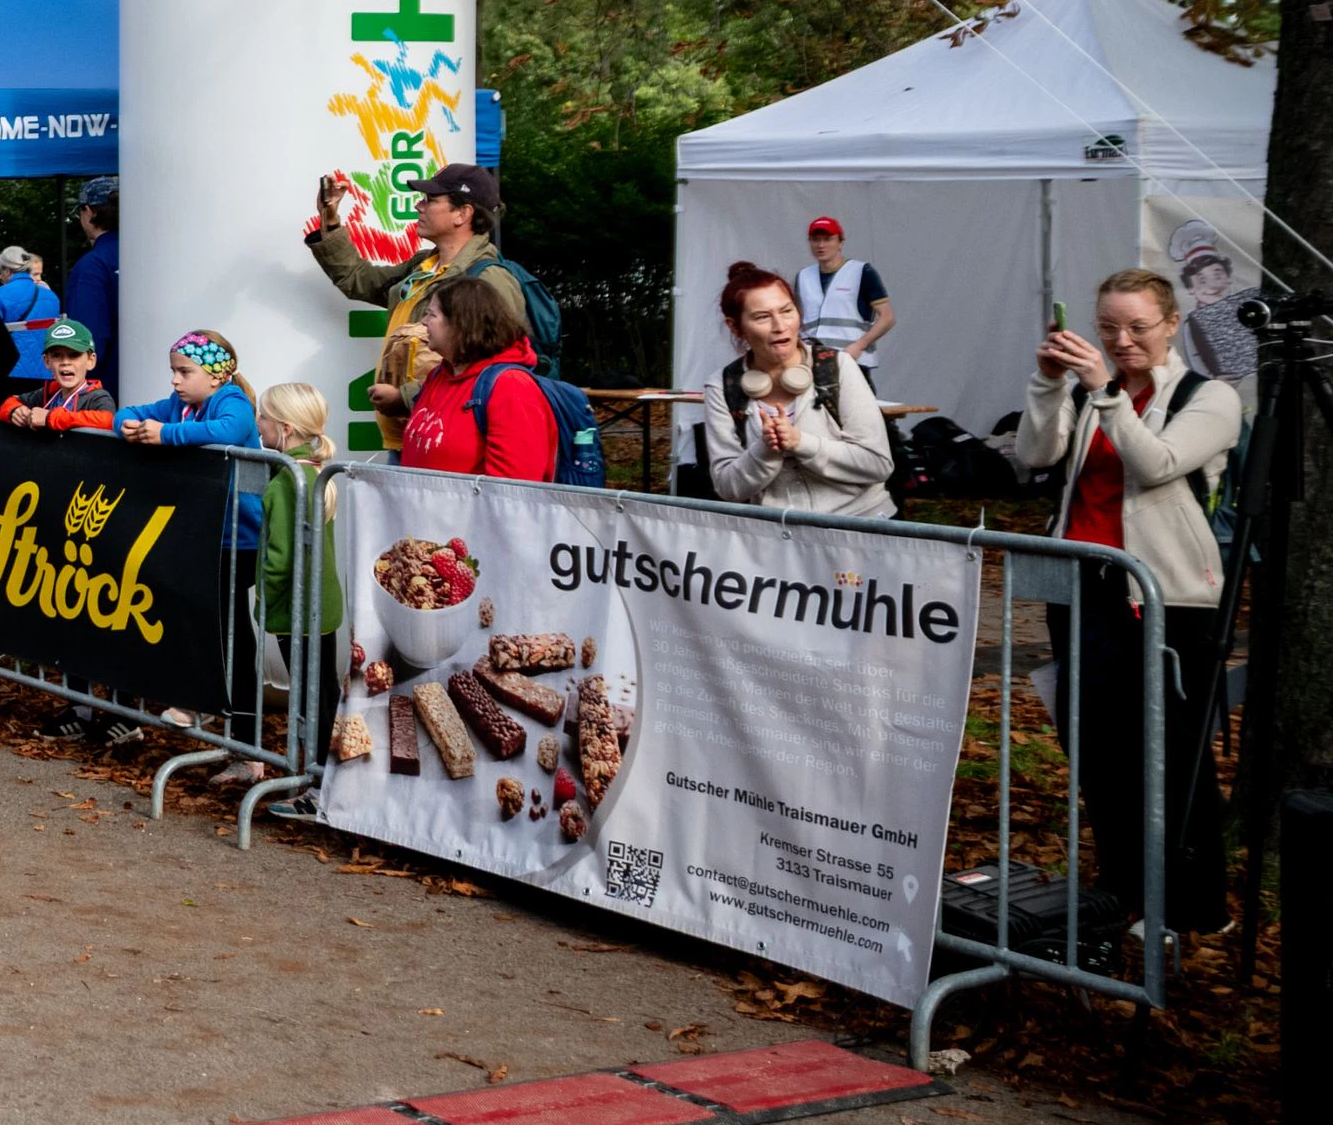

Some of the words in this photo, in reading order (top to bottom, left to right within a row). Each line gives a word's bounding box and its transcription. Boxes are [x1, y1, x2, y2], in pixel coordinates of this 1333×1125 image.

[549, 539, 960, 645] gutschermühle
[652, 639, 670, 654] 30
[833, 676, 892, 700] Snacks
[896, 687, 918, 704] für
[923, 694, 947, 710] die
[741, 678, 791, 701] Marken
[795, 691, 817, 707] der
[821, 697, 854, 715] Welt
[859, 706, 890, 721] und
[857, 661, 894, 678] über
[656, 681, 672, 694] so
[675, 683, 694, 699] die
[740, 702, 765, 718] des
[848, 723, 872, 739] Mit
[878, 730, 945, 753] unserem
[656, 699, 720, 723] Firmensitz
[811, 736, 841, 753] sind
[844, 745, 866, 759] wir
[870, 749, 910, 768] einer
[913, 756, 938, 773] der
[776, 745, 800, 765] der
[804, 754, 859, 779] Region.
[666, 771, 730, 799] Gutscher
[733, 788, 775, 813] Mühle
[777, 800, 868, 836] Traismauer
[871, 823, 919, 850] GmbH
[759, 831, 813, 860] Kremser
[816, 848, 872, 875] Strasse
[876, 862, 895, 881] 55
[775, 857, 811, 879] 3133
[812, 867, 894, 902] Traismauer
[686, 864, 891, 934] contact@gutschermuehle.com
[709, 890, 884, 954] www.gutschermuehle.com
